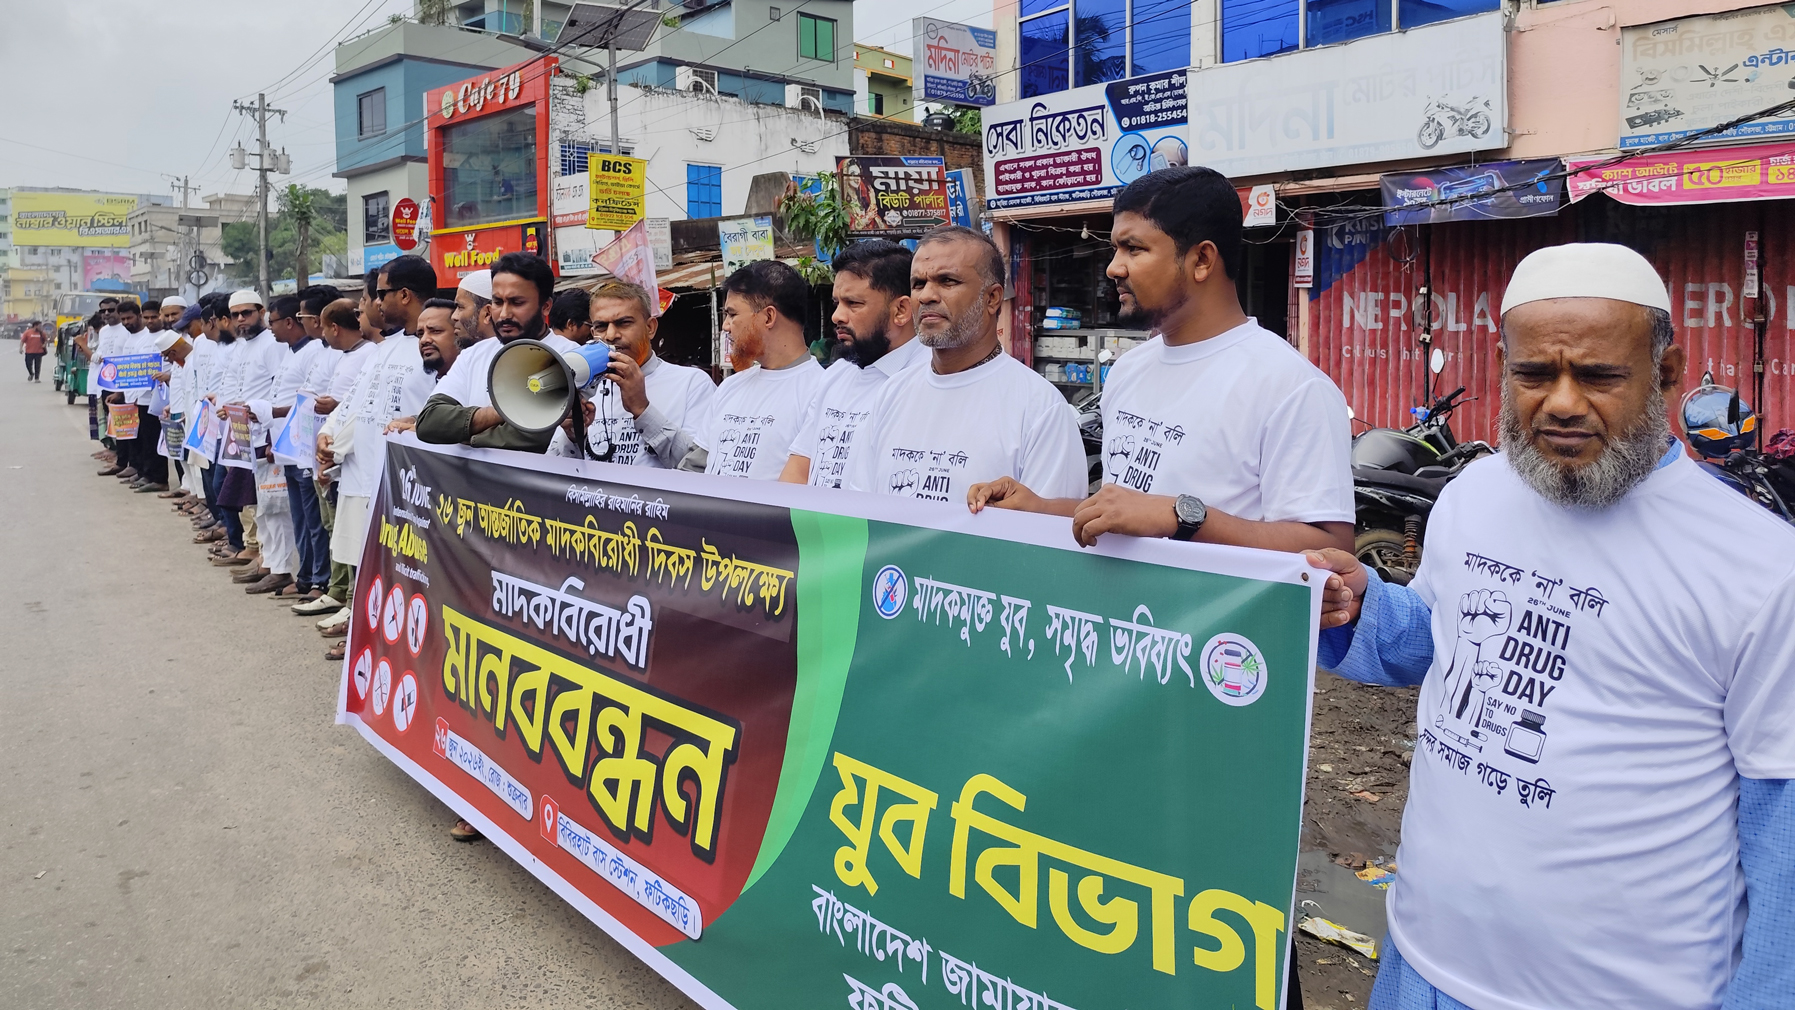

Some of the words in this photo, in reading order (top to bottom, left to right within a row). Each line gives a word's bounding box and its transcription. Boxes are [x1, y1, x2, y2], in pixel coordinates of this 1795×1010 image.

[1651, 24, 1679, 37] মেসার্স
[926, 35, 960, 75] মদিনা
[961, 49, 979, 68] মোটর
[457, 76, 496, 113] Cafe
[499, 70, 522, 104] 79
[1149, 79, 1169, 93] কুমার
[1170, 74, 1186, 87] শীল
[986, 119, 1025, 156] সেবা
[1029, 102, 1107, 149] নিকেতন
[1131, 109, 1187, 126] 01818-255454
[601, 159, 632, 174] BCS
[999, 162, 1018, 172] এখানে
[1601, 167, 1632, 181] ক্যাশ
[1635, 162, 1678, 177] আউটে
[869, 166, 939, 194] মায়া
[1626, 176, 1678, 194] ডাবল
[878, 191, 910, 209] বিউটি
[914, 191, 945, 209] পার্লার
[16, 217, 53, 230] নাম্বার
[93, 211, 127, 227] স্টিল
[1253, 208, 1273, 217] নগদ
[722, 227, 749, 243] বৈরাগী
[751, 229, 769, 241] বাবা
[444, 250, 469, 268] Well
[471, 247, 501, 265] Food
[619, 431, 641, 442] ANTI
[741, 432, 760, 445] ANTI
[1116, 410, 1146, 429] মাদককে
[1163, 425, 1186, 446] বলি
[615, 443, 640, 454] DRUG
[733, 446, 757, 460] DRUG
[892, 447, 925, 463] মাদককে
[948, 450, 969, 469] বলি
[1134, 446, 1161, 471] ANTI
[732, 460, 752, 473] DAY
[922, 475, 950, 493] ANTI
[1123, 465, 1154, 493] DRUG
[411, 482, 431, 509] JUNE
[565, 483, 606, 509] বিসমিল্লাহির
[607, 491, 644, 516] রাহমানির
[645, 497, 670, 520] রাহিম
[398, 523, 428, 565] Abuse
[436, 493, 454, 527] ২৬
[457, 498, 475, 539] জুন
[477, 497, 541, 549] আন্তর্জাতিক
[545, 514, 642, 576] মাদকবিরোধী
[645, 527, 697, 590] দিবস
[1464, 551, 1525, 586] মাদককে
[1531, 569, 1564, 600] ‘না’
[1569, 586, 1610, 618] বলি
[491, 570, 652, 669] মাদকবিরোধী
[1527, 597, 1546, 607] 26TH
[1547, 604, 1571, 619] JUNE
[913, 574, 997, 648] মাদকমুক্ত
[999, 594, 1036, 661] যুব,
[1045, 604, 1104, 685] সমৃদ্ধ
[1109, 603, 1195, 689] ভবিষ্যৎ
[1516, 609, 1571, 651] ANTI
[1499, 635, 1567, 681] DRUG
[1502, 669, 1556, 708] DAY
[1485, 708, 1494, 719] TO
[1486, 697, 1504, 710] SAY
[1503, 702, 1517, 716] NO
[442, 603, 737, 851] মানববন্ধন
[1481, 718, 1507, 737] DRUGS
[449, 737, 459, 760] জুন
[488, 766, 502, 790] রোজ
[1437, 740, 1473, 776] সমাজ
[1477, 761, 1512, 795] গড়ে
[1516, 777, 1557, 809] তুলি
[558, 816, 591, 857] বিবিরহাট
[593, 843, 608, 871] বাস
[644, 879, 690, 930] ফটিকছড়ি
[829, 751, 939, 897] যুব
[949, 773, 1285, 1010] বিভাগ
[811, 883, 933, 985] বাংলাদেশ
